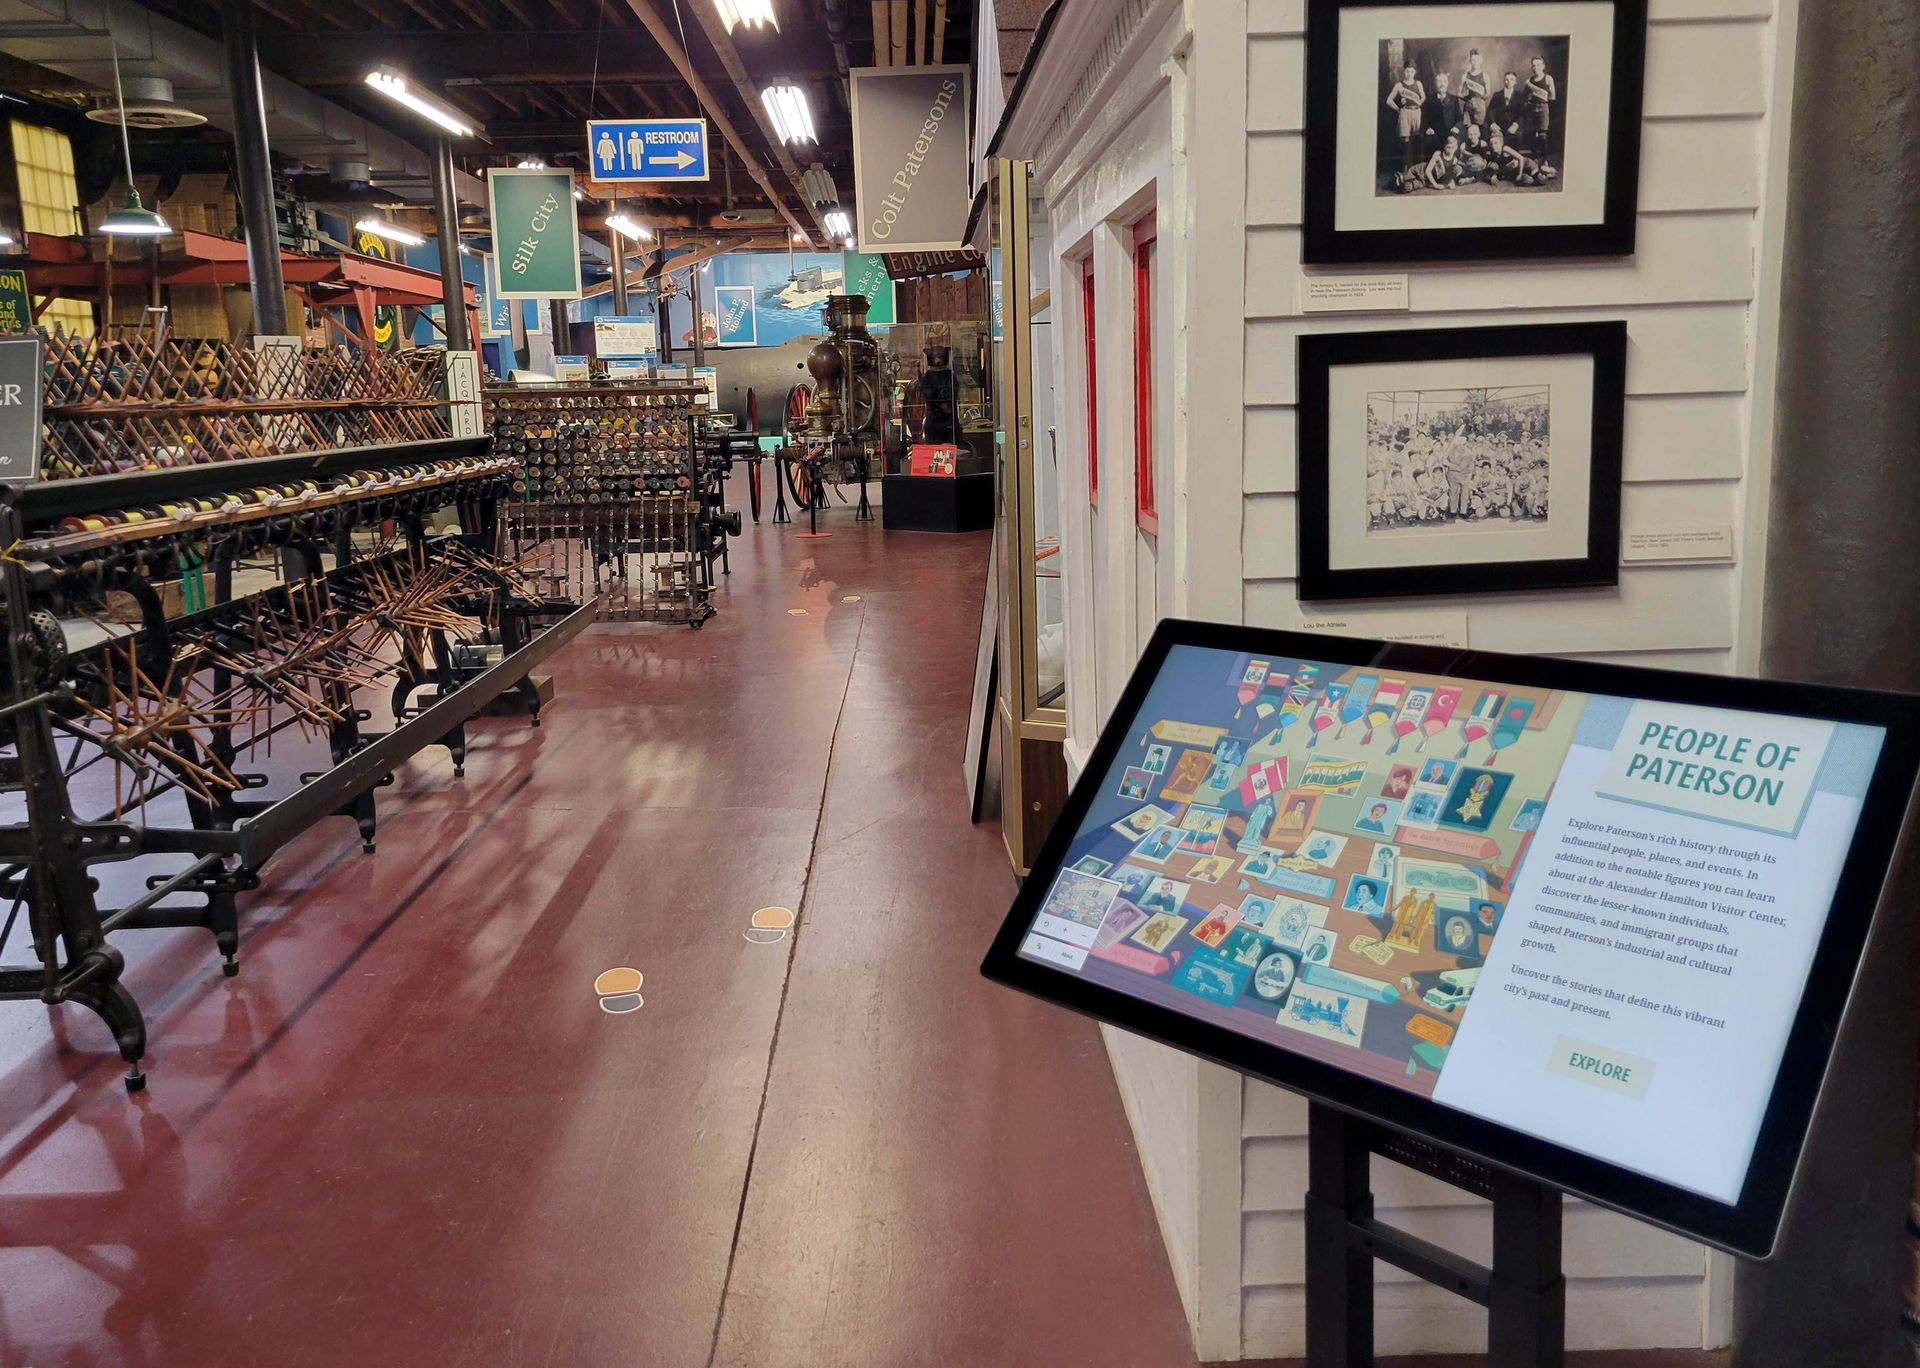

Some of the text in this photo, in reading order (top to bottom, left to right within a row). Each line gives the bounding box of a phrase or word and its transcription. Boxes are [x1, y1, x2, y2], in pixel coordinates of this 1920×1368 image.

[645, 131, 699, 145] RESTROOM
[871, 79, 957, 239] Colt Patersons
[512, 193, 560, 275] Silk City
[0, 275, 22, 292] ON
[868, 257, 879, 267] &
[6, 299, 17, 310] of
[722, 299, 741, 329] John P.
[729, 299, 749, 333] Holland
[1639, 721, 1801, 772] PEOPLE OF
[1625, 753, 1785, 807] PATERSON
[1560, 834, 1759, 881] influential people, places, and events. In
[1567, 817, 1605, 832] Explore
[1656, 834, 1677, 846] rich
[1678, 837, 1717, 855] history
[1717, 845, 1761, 862] through
[1762, 853, 1777, 864] its
[1547, 868, 1787, 928] about at the Alexander Hamilton Visitor Center,
[1554, 852, 1776, 904] addition to the notable figures you can learn
[1534, 903, 1739, 958] communities, and immigrant groups that
[1541, 884, 1730, 936] discover the lesser-known individuals,
[1519, 938, 1557, 954] growth.
[1527, 919, 1563, 936] shaped
[1613, 939, 1665, 961] industrial
[1665, 953, 1688, 966] and
[1688, 959, 1733, 977] cultural
[1511, 963, 1726, 1029] Uncover the stories that define this vibrant
[1527, 990, 1550, 1003] past
[1550, 996, 1571, 1009] and
[1569, 1002, 1611, 1020] present.
[1568, 1052, 1632, 1083] EXPLORE
